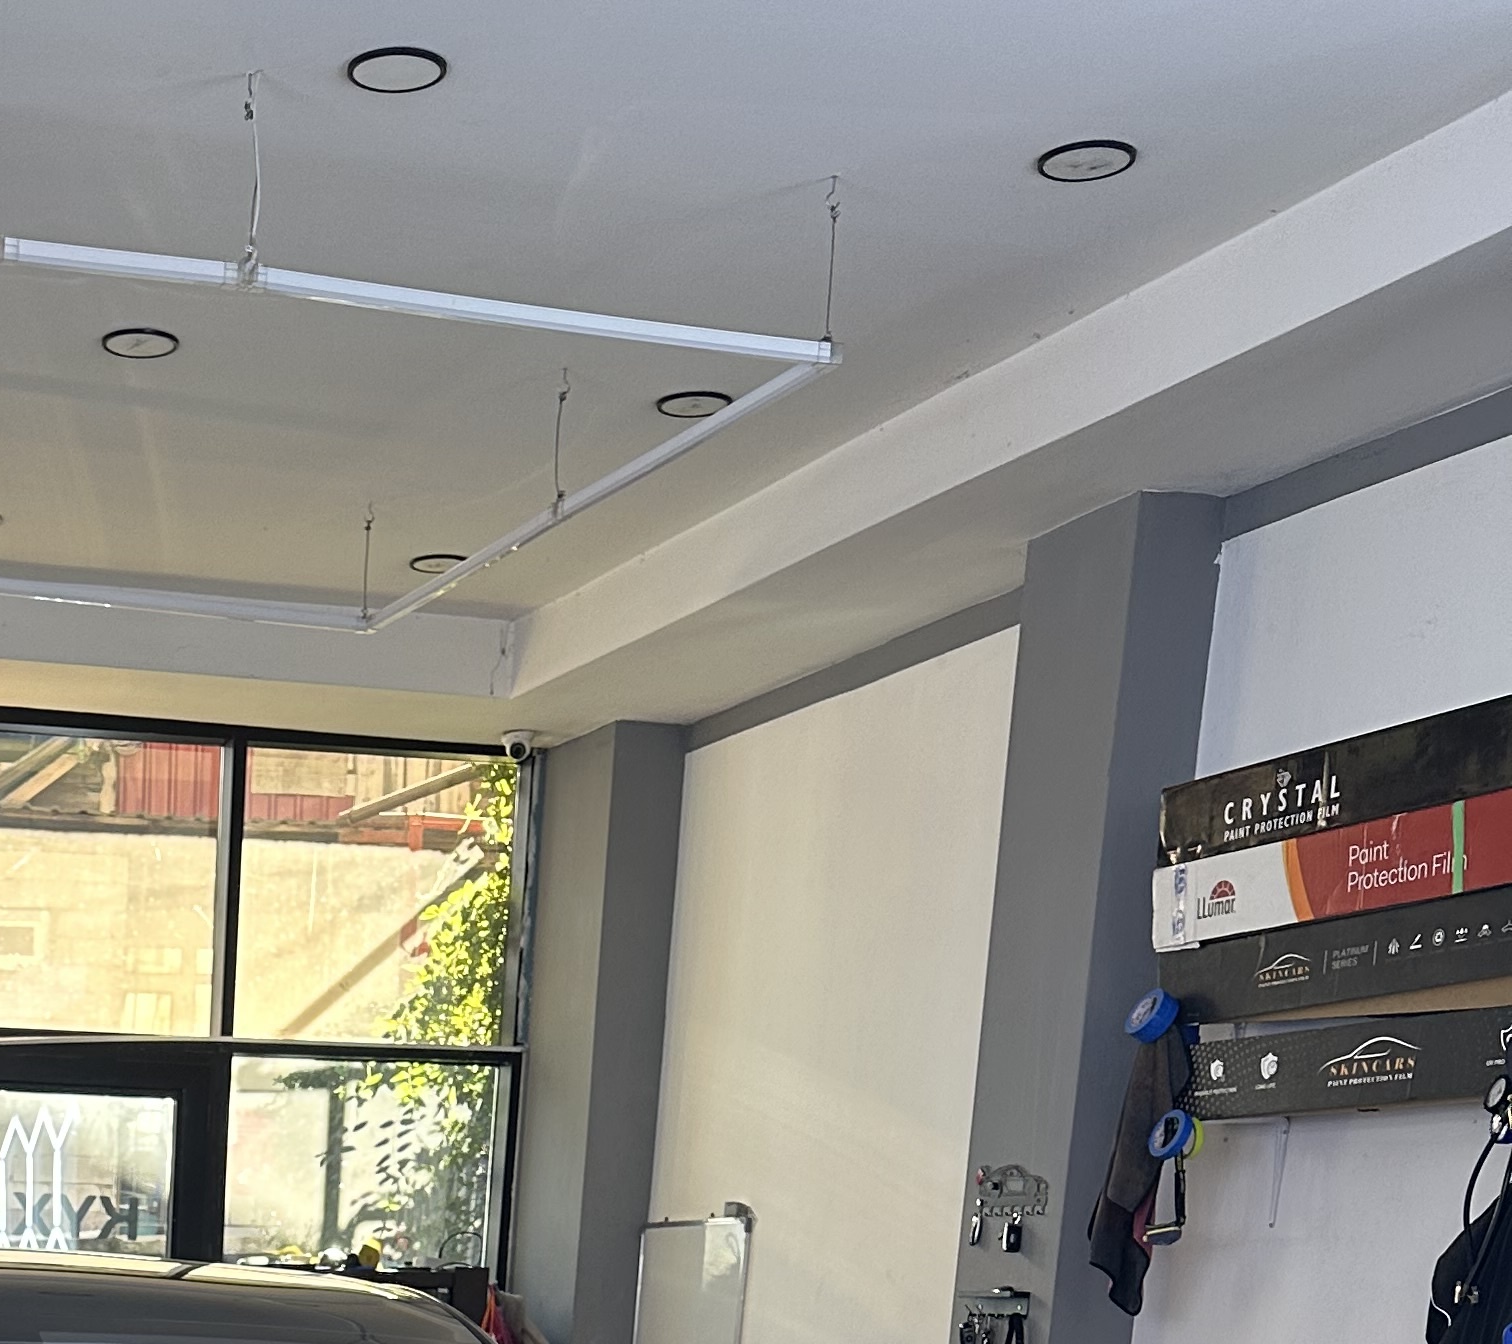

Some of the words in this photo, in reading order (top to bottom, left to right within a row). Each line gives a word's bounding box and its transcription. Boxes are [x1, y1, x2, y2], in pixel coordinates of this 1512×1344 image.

[1224, 775, 1340, 824] CRYSTAL
[1224, 825, 1250, 842] PAINT
[1254, 810, 1313, 835] PROTECTION
[1317, 803, 1340, 820] FILM
[1348, 840, 1390, 866] Paint
[1347, 861, 1427, 892] Protection
[1330, 1056, 1416, 1076] SKINCARS
